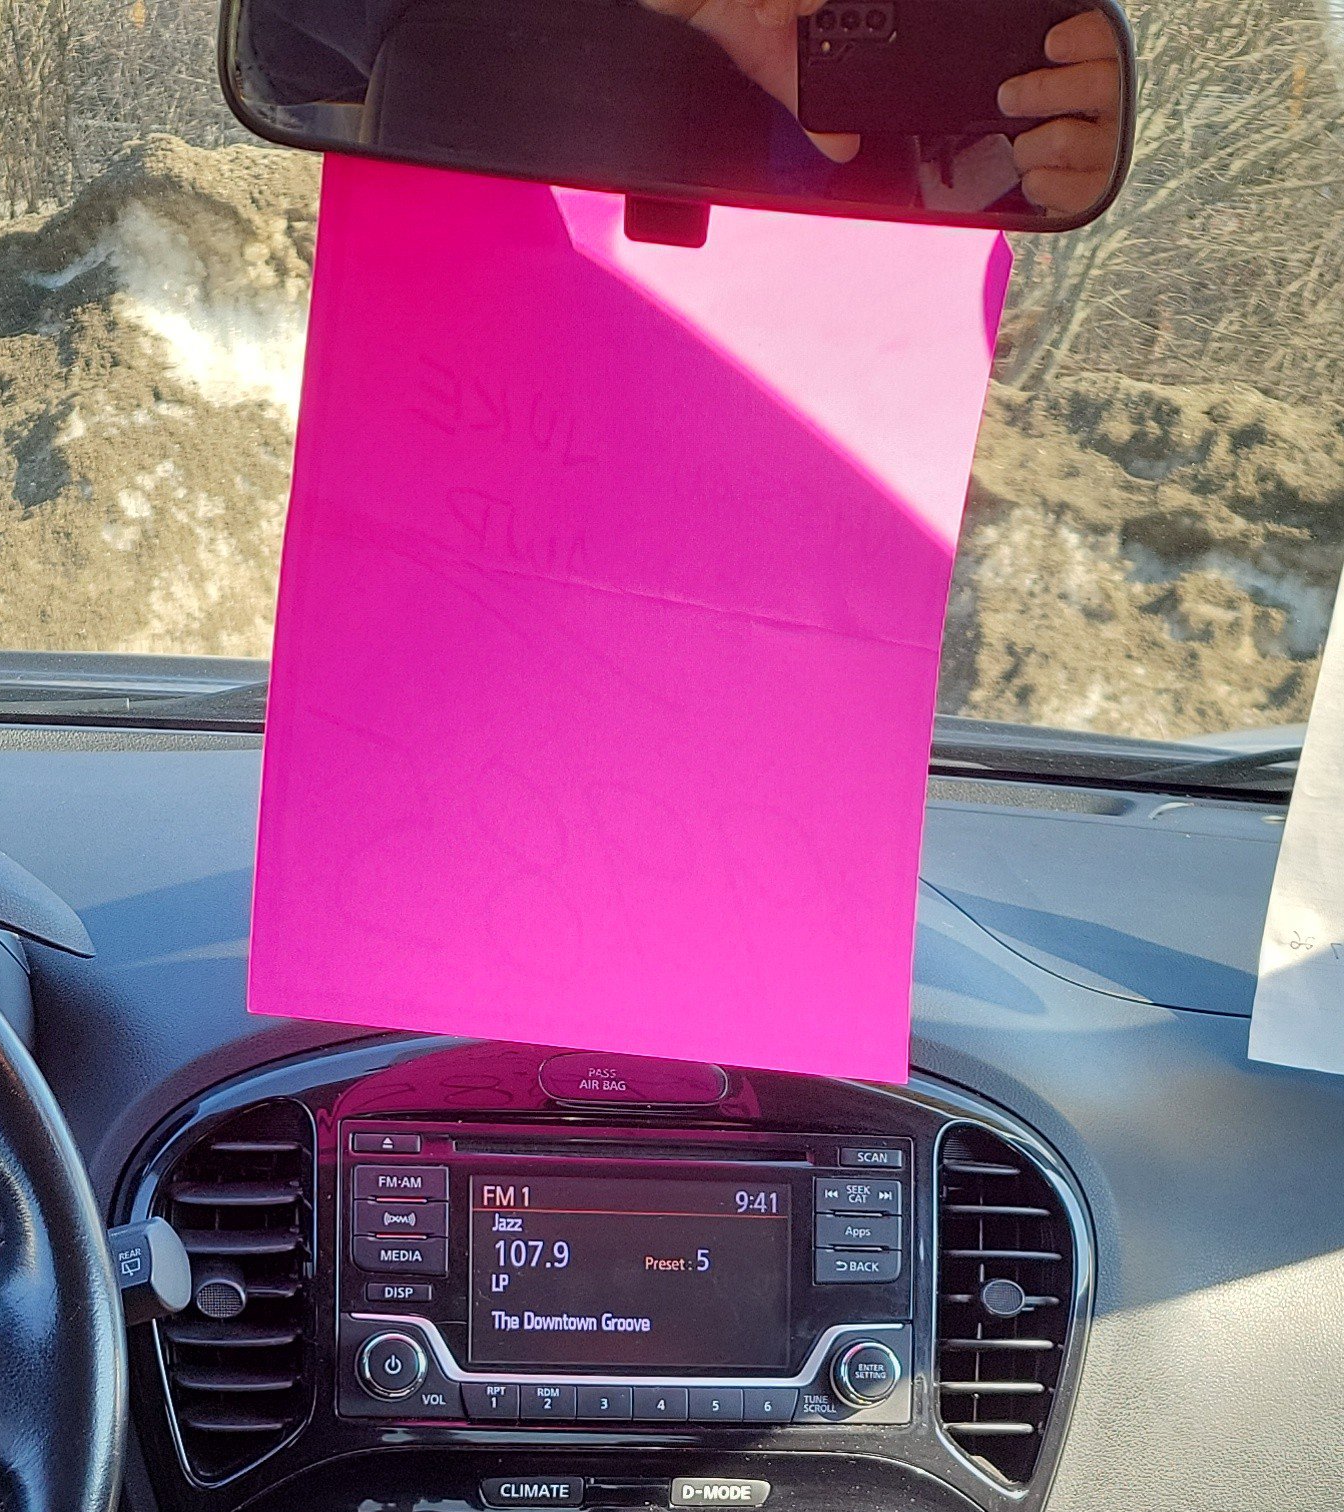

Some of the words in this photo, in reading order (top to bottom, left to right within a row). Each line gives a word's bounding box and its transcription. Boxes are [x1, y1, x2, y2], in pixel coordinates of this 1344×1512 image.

[587, 1068, 617, 1079] PASS
[579, 1079, 600, 1091] AIR
[602, 1080, 626, 1092] BAG
[856, 1151, 888, 1163] SCAN
[483, 1185, 516, 1207] FM
[521, 1185, 531, 1207] 1
[845, 1184, 870, 1196] SEEK
[735, 1191, 778, 1214] 9:41
[848, 1193, 868, 1204] CAT
[492, 1214, 523, 1234] Jazz
[845, 1224, 871, 1239] Apps
[118, 1248, 142, 1262] REAR
[380, 1249, 422, 1262] MEDIA
[494, 1239, 570, 1270] 107.9
[645, 1256, 685, 1272] Preset
[696, 1249, 710, 1271] 5
[849, 1260, 880, 1274] BACK
[492, 1273, 509, 1292] LP
[384, 1286, 414, 1298] DISP
[492, 1312, 519, 1332] The
[523, 1312, 597, 1333] Downtown
[601, 1313, 651, 1333] Groove
[486, 1385, 507, 1396] RPT
[537, 1387, 560, 1397] RDM
[422, 1393, 447, 1406] VOL
[543, 1398, 552, 1410] 2
[599, 1398, 609, 1411] 3
[656, 1399, 666, 1412] 4
[711, 1400, 720, 1412] 5
[803, 1394, 829, 1406] TUNE
[763, 1401, 772, 1413] 6
[803, 1403, 838, 1415] SCROLL
[499, 1482, 570, 1499] CLIMATE
[681, 1484, 752, 1501] D-MODE
